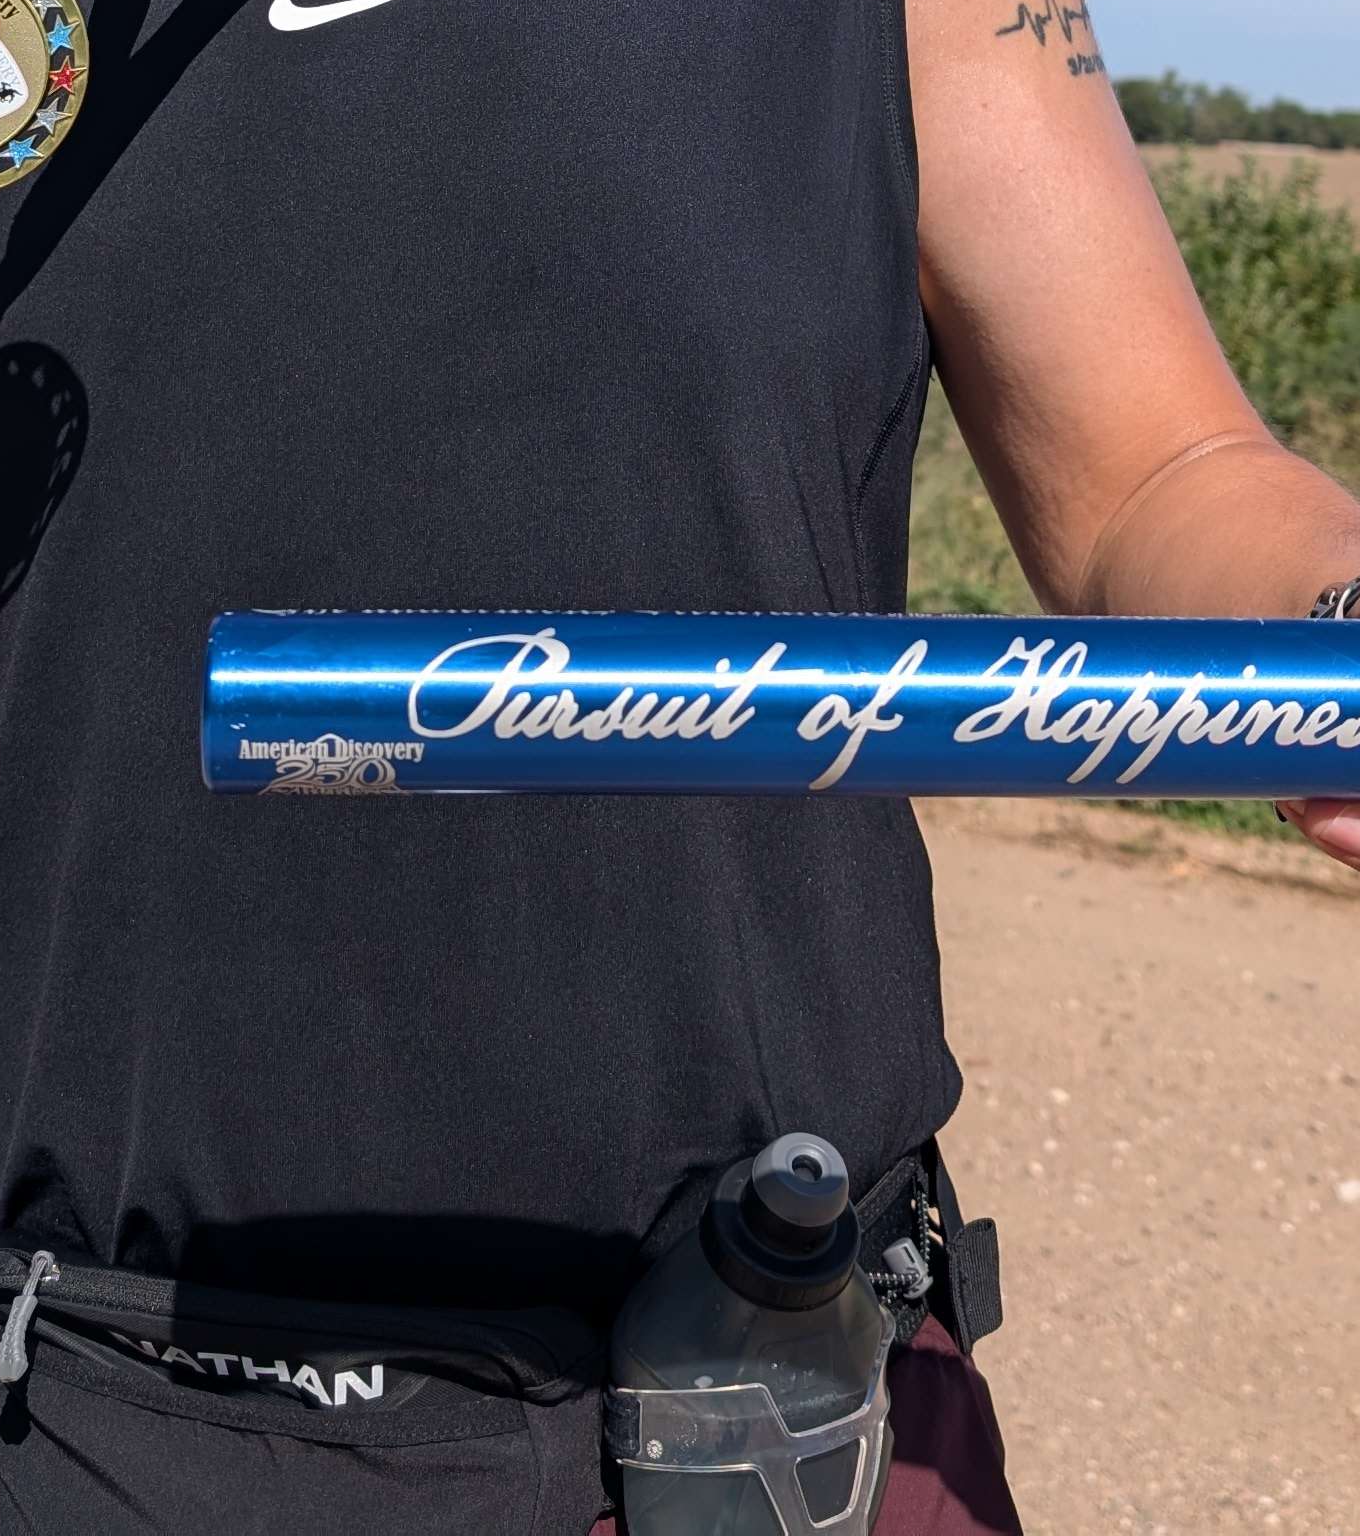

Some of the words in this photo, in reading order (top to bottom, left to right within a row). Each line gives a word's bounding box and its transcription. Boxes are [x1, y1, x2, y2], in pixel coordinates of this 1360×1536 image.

[409, 628, 824, 741] Pursuit
[796, 638, 927, 790] of
[239, 738, 329, 760] American
[339, 738, 425, 763] Discovery
[270, 757, 397, 787] 250
[108, 1329, 384, 1406] NATHAN
